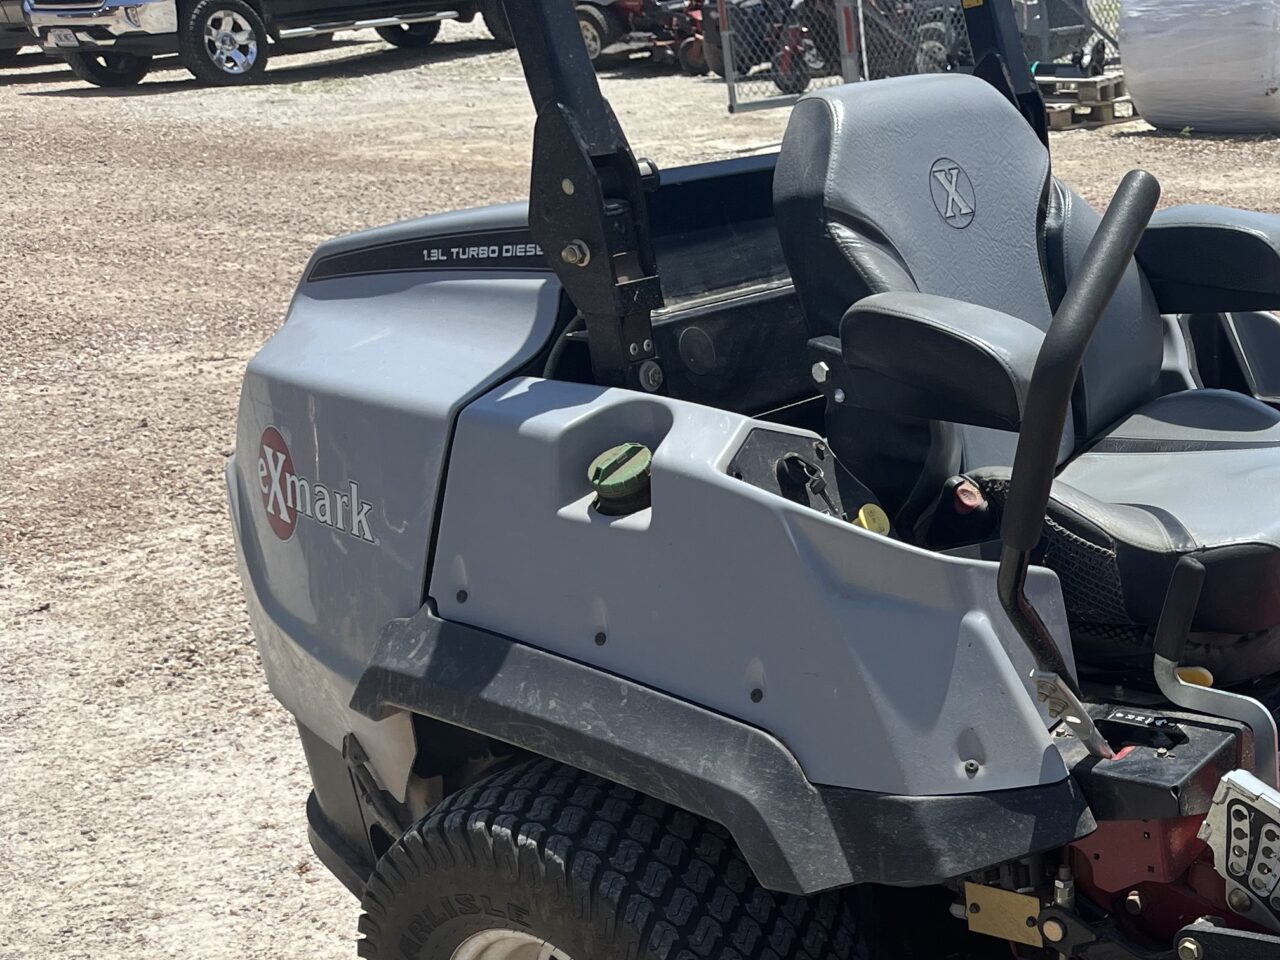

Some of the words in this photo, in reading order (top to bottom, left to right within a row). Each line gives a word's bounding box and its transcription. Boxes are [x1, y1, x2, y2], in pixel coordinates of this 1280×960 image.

[932, 167, 974, 218] X
[422, 248, 447, 261] 1.3L
[450, 245, 499, 259] TURBO
[502, 243, 544, 257] DIESE
